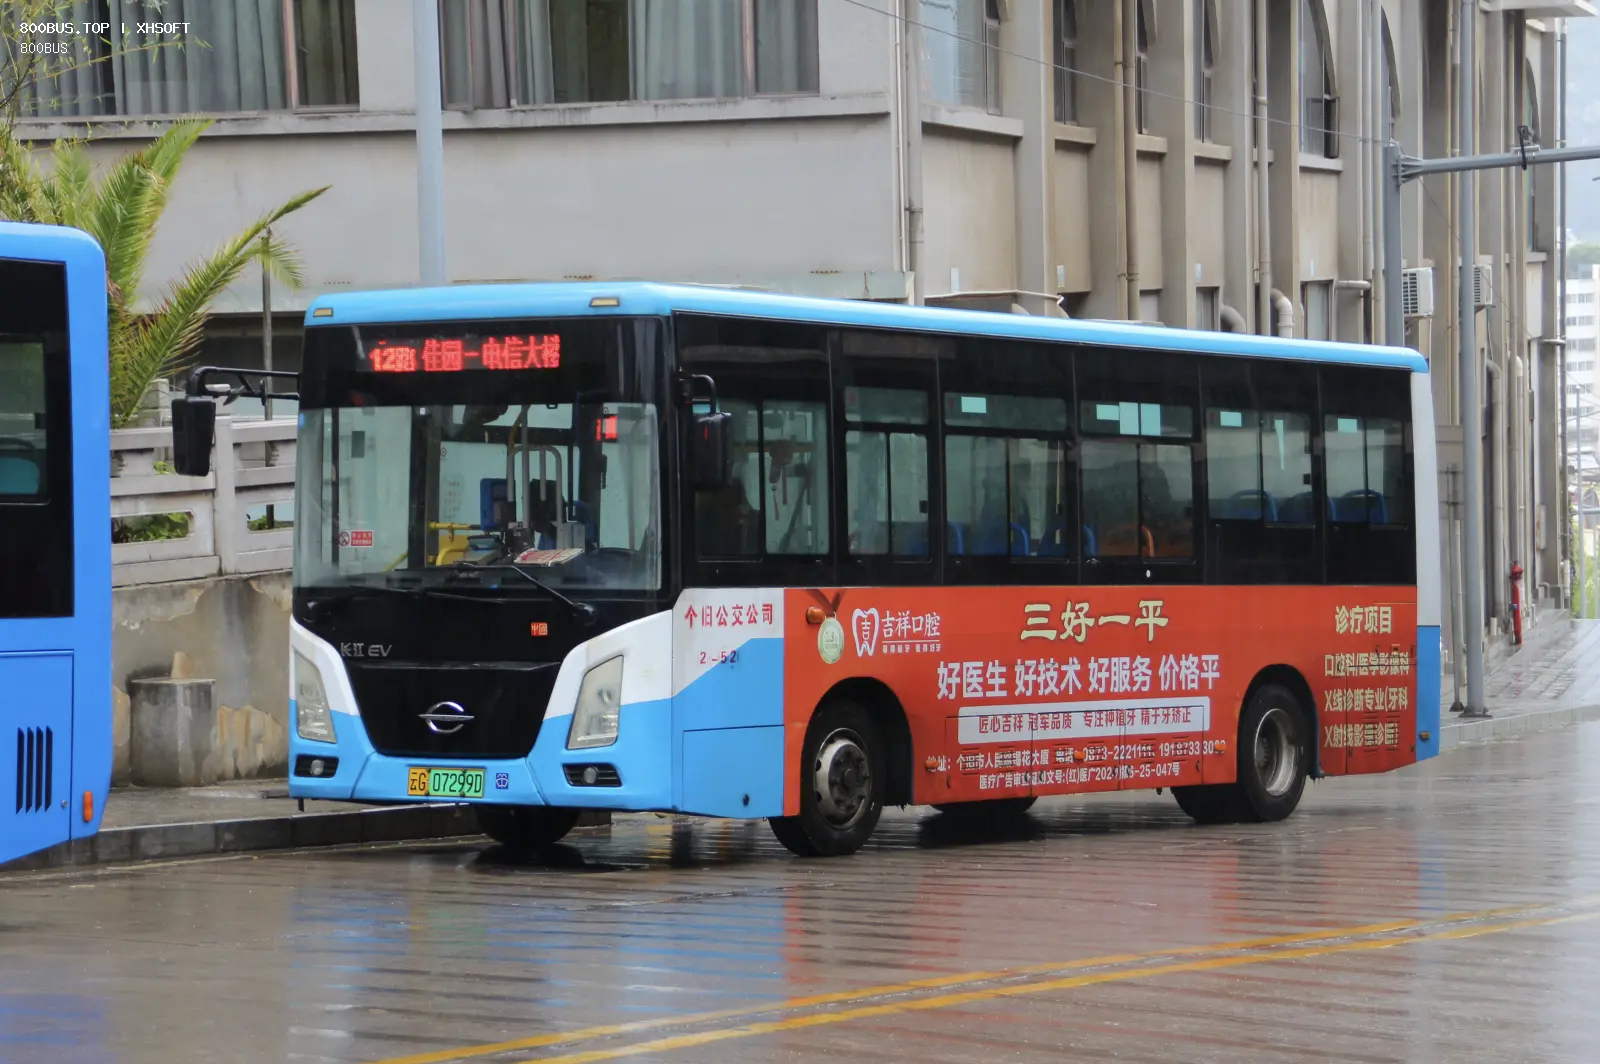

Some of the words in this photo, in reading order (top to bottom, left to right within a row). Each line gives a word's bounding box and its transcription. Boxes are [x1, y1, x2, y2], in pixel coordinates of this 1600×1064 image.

[684, 603, 773, 629] 个旧公交公司
[881, 610, 941, 639] 吉祥口腔
[1020, 599, 1169, 643] 三好一平
[1334, 605, 1392, 634] 诊疗项目
[368, 644, 393, 657] EV
[699, 650, 737, 664] 2-52
[937, 659, 1008, 700] 好医生
[1014, 656, 1082, 697] 好技术
[1088, 654, 1152, 694] 好服务
[1158, 652, 1220, 691] 价格平
[1324, 651, 1410, 677] 口腔科/医学影像科
[1324, 686, 1408, 712] X线诊断专业(牙科
[978, 713, 1024, 735] 匠心吉祥
[1028, 710, 1073, 731] 冠军品质
[1083, 706, 1137, 728] 专注种植牙
[1140, 704, 1193, 725] 精于牙矫正
[409, 771, 427, 792] 云G
[432, 772, 483, 793] 07299D
